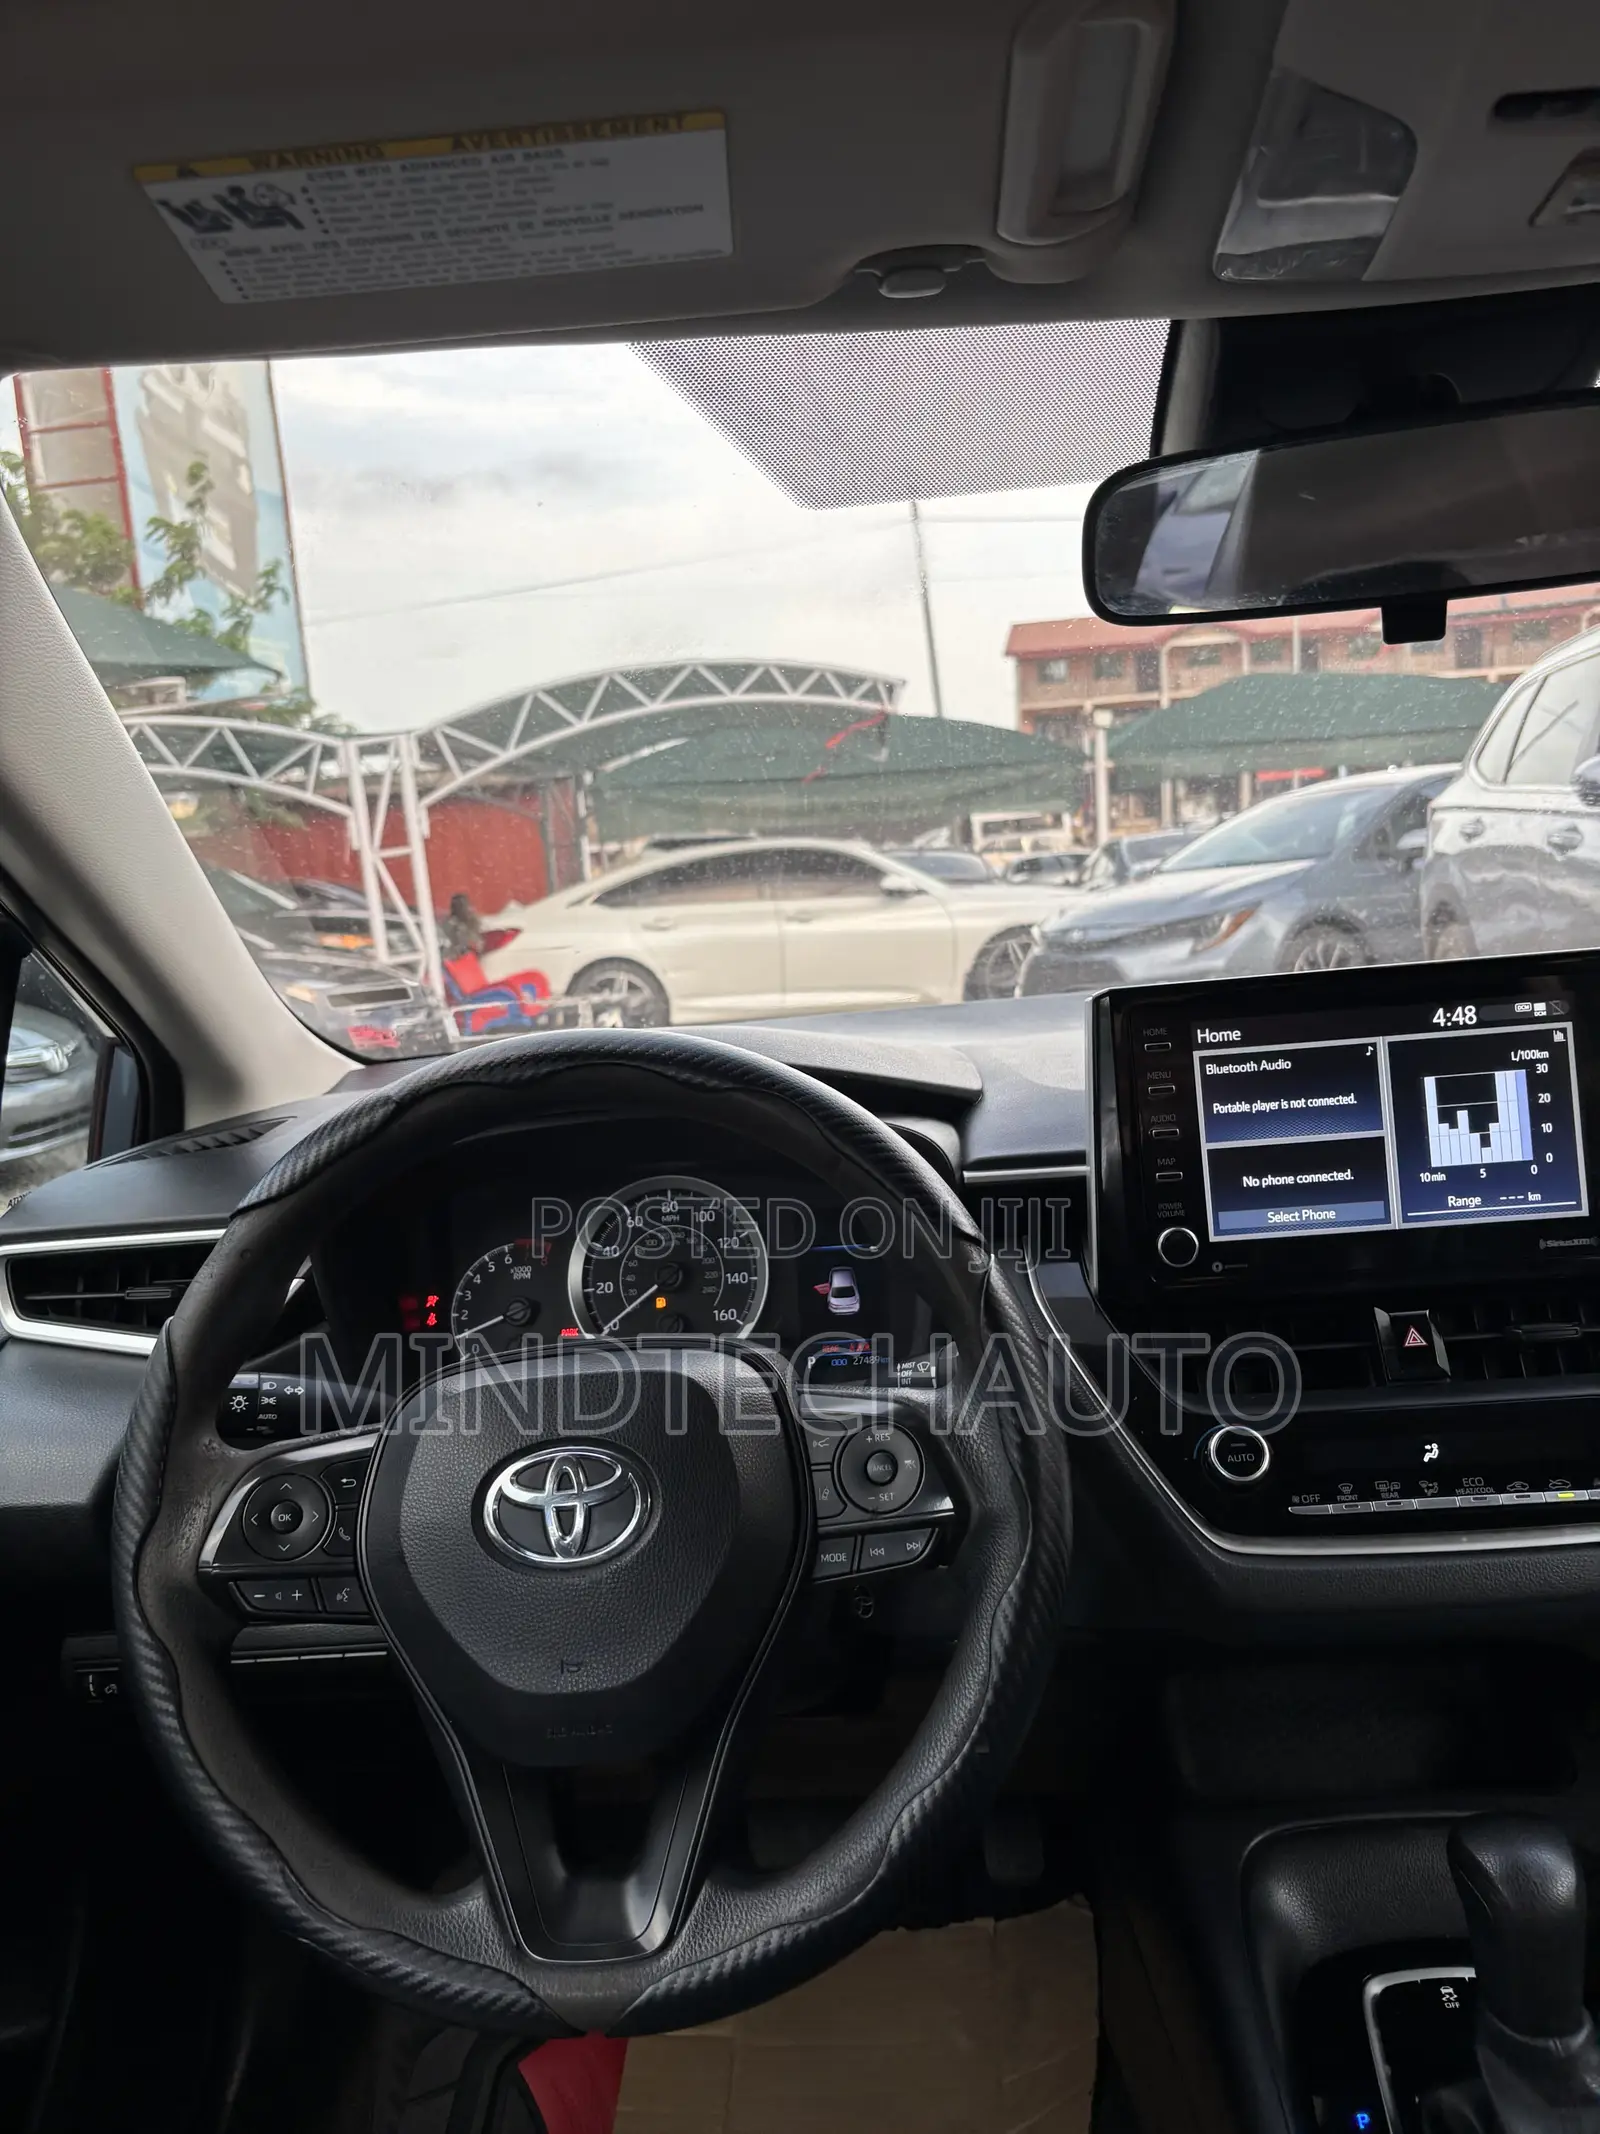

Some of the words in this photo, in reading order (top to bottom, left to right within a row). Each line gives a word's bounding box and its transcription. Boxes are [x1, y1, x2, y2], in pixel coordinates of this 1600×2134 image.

[1432, 1004, 1478, 1027] 4:48
[1143, 1027, 1168, 1037] HOME
[1196, 1028, 1242, 1045] Home
[1510, 1049, 1550, 1062] L/100km
[1206, 1061, 1258, 1076] Bluetooth
[1260, 1058, 1292, 1072] Audio
[1535, 1063, 1549, 1074] 30
[1147, 1071, 1172, 1080] MENU
[1213, 1101, 1251, 1115] Portable
[1252, 1099, 1280, 1114] player
[1280, 1098, 1289, 1110] is
[1290, 1096, 1306, 1109] not
[1307, 1092, 1358, 1108] connected.
[1538, 1093, 1552, 1104] 20
[1150, 1113, 1176, 1123] AUDIO
[1541, 1123, 1553, 1133] 10
[1157, 1157, 1176, 1167] MAP
[1545, 1152, 1554, 1163] 0
[1480, 1168, 1487, 1179] 5
[1530, 1165, 1538, 1175] 0
[1243, 1175, 1260, 1188] No
[1262, 1173, 1295, 1189] phone
[1296, 1168, 1355, 1185] connected.
[1419, 1172, 1431, 1183] 10
[1431, 1172, 1447, 1182] min
[1447, 1195, 1482, 1208] Range
[1528, 1191, 1542, 1202] km
[661, 1201, 679, 1214] 80
[1158, 1202, 1183, 1210] POWER
[661, 1214, 680, 1223] MPH
[693, 1210, 716, 1223] 100
[1157, 1210, 1186, 1219] VOLUME
[1267, 1210, 1300, 1224] Select
[1302, 1208, 1336, 1222] Phone
[627, 1215, 644, 1228] 60
[717, 1236, 740, 1249] 120
[602, 1245, 620, 1258] 40
[504, 1254, 512, 1265] 6
[488, 1261, 496, 1273] 5
[472, 1274, 482, 1285] 4
[513, 1272, 532, 1281] RPM
[725, 1271, 749, 1285] 140
[596, 1281, 614, 1295] 20
[464, 1290, 472, 1301] 3
[460, 1310, 469, 1321] 2
[712, 1308, 738, 1321] 160
[610, 1319, 620, 1332] 0
[471, 1343, 480, 1354] 0
[807, 1357, 816, 1369] P
[901, 1361, 916, 1370] MIST
[901, 1370, 913, 1378] OFF
[257, 1413, 278, 1421] AUTO
[875, 1433, 891, 1443] RES
[1227, 1452, 1256, 1464] AUTO
[1462, 1477, 1485, 1487] ECO
[1380, 1491, 1400, 1499] REAR
[1455, 1486, 1496, 1496] HEAT/COOL
[878, 1492, 895, 1503] SET
[1301, 1493, 1321, 1504] OFF
[1336, 1494, 1358, 1502] FRONT
[278, 1513, 292, 1522] OK
[820, 1552, 848, 1564] MODE
[1355, 2112, 1370, 2129] P
